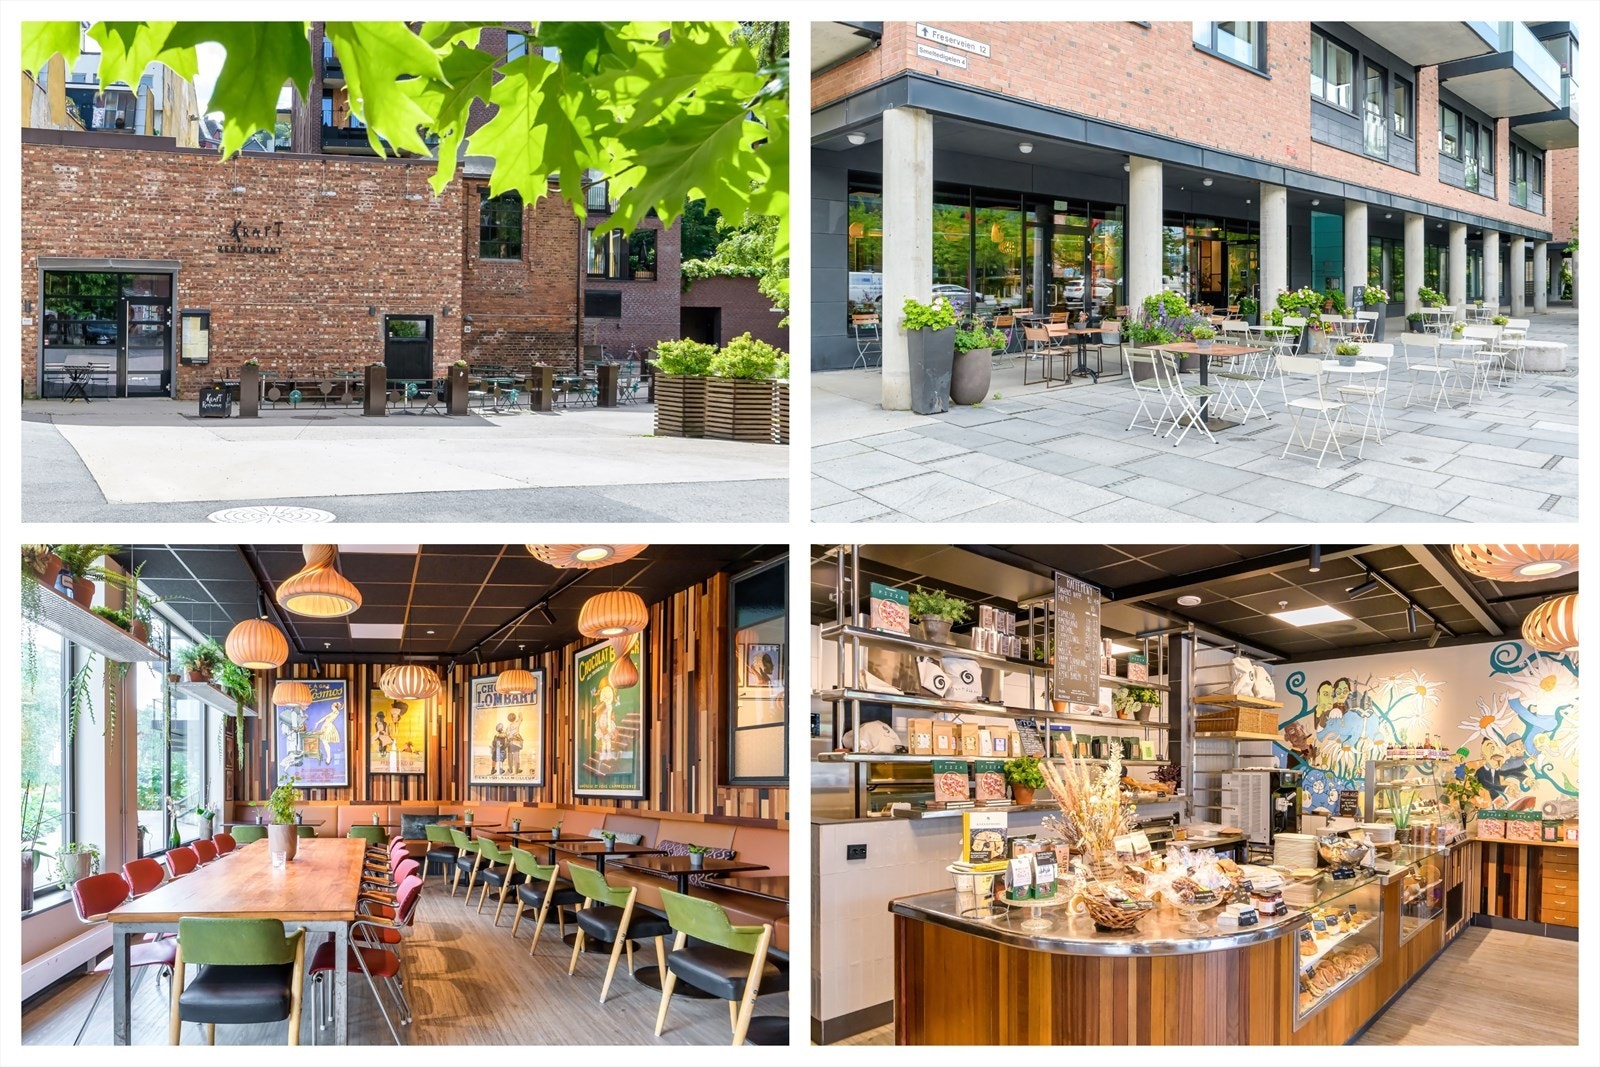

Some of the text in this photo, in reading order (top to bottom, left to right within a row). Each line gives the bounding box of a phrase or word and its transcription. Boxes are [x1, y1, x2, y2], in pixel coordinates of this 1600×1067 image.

[980, 45, 987, 54] 12
[217, 244, 282, 255] RESTAURANT
[878, 589, 904, 600] PIZZA
[477, 689, 536, 708] LOMBART
